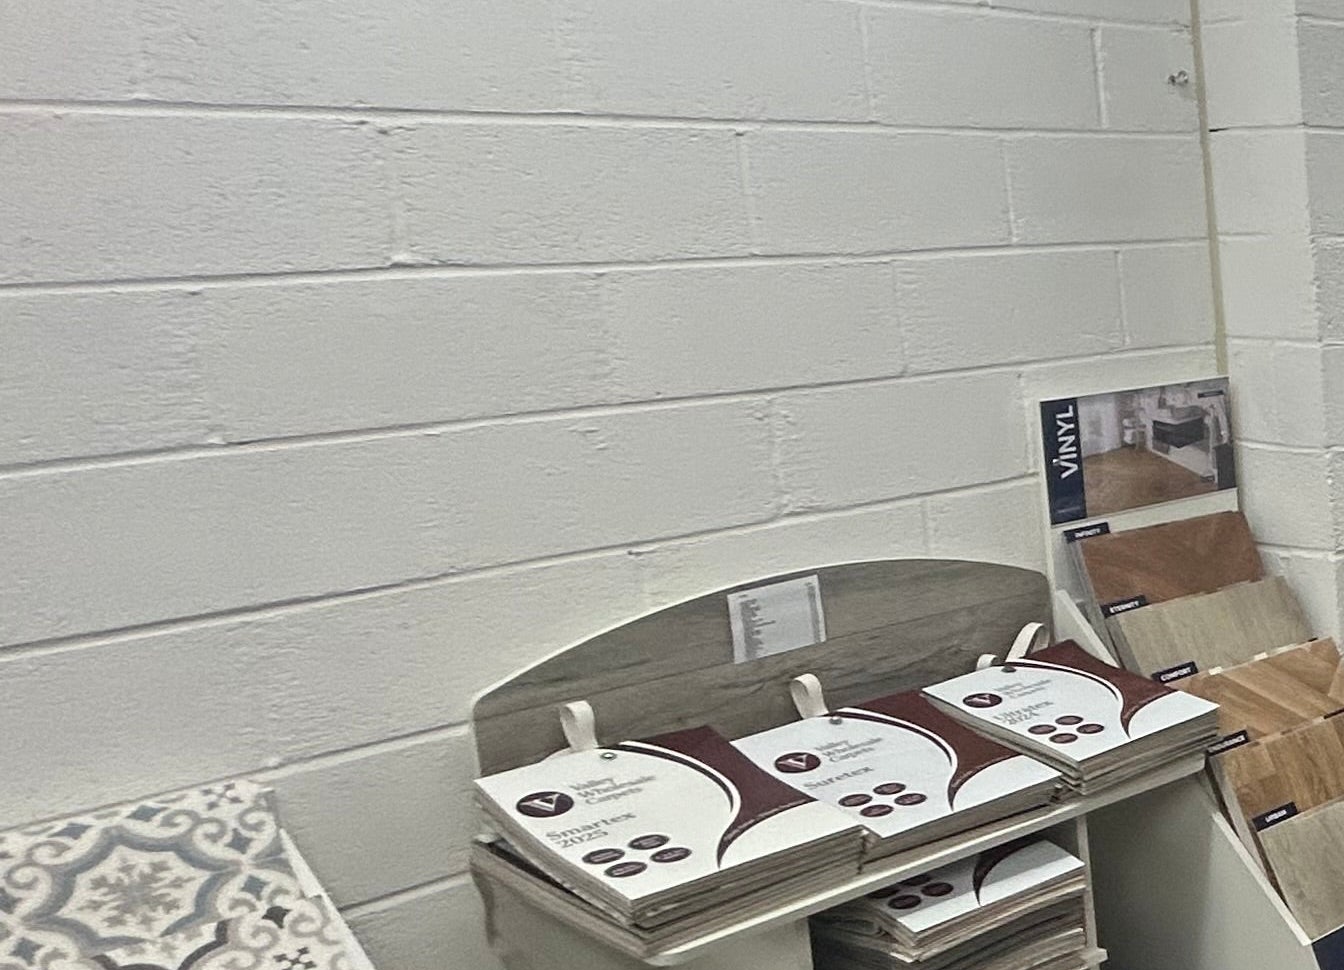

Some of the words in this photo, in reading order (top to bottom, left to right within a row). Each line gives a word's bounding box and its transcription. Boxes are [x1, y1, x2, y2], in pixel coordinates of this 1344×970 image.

[1055, 404, 1079, 479] VINYL
[803, 766, 875, 790] Suretex
[546, 812, 637, 841] Smartex
[556, 830, 609, 849] 2025
